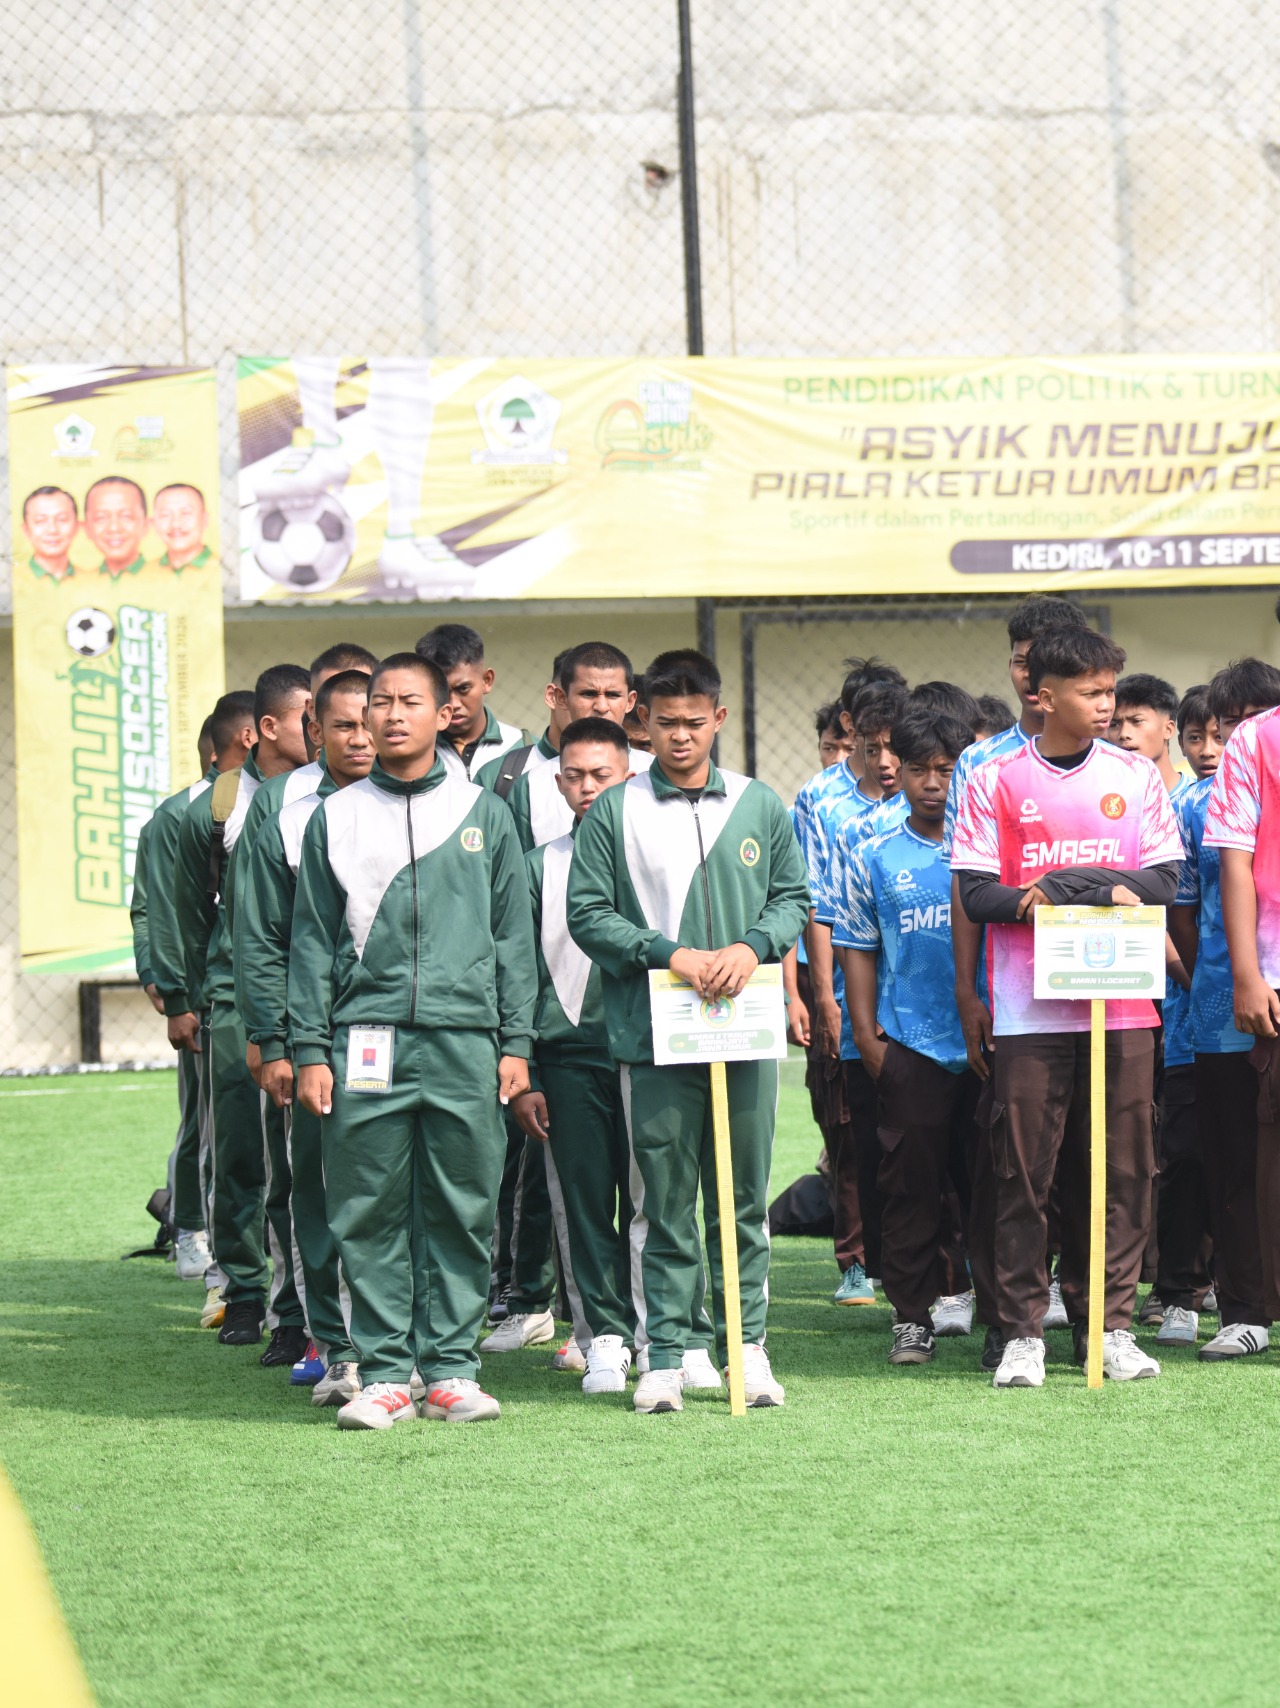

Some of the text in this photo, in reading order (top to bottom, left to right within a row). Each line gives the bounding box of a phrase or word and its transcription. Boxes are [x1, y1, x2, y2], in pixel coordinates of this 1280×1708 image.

[784, 375, 1003, 403] PENDIDIKAN
[1017, 372, 1150, 401] POLITIK
[1164, 371, 1182, 399] &
[841, 424, 1030, 460] "ASYIK
[750, 471, 892, 500] PIALA
[903, 468, 1056, 498] KETUA
[1067, 465, 1219, 495] UMUM
[789, 508, 868, 532] Sportif
[877, 508, 943, 528] dalam
[949, 507, 1104, 532] Pertandingan,
[1168, 503, 1232, 523] dalam
[1012, 543, 1110, 571] KEDIRI,
[1118, 540, 1192, 568] 10-11
[120, 604, 154, 790] SOCCER
[151, 611, 170, 792] MENUJU PUNCAK
[177, 653, 190, 735] SEPTEMBER
[72, 685, 123, 908] BAHLIL
[1021, 838, 1125, 868] SMASAL
[900, 903, 951, 934] SMA
[348, 1080, 387, 1089] PESERTA
